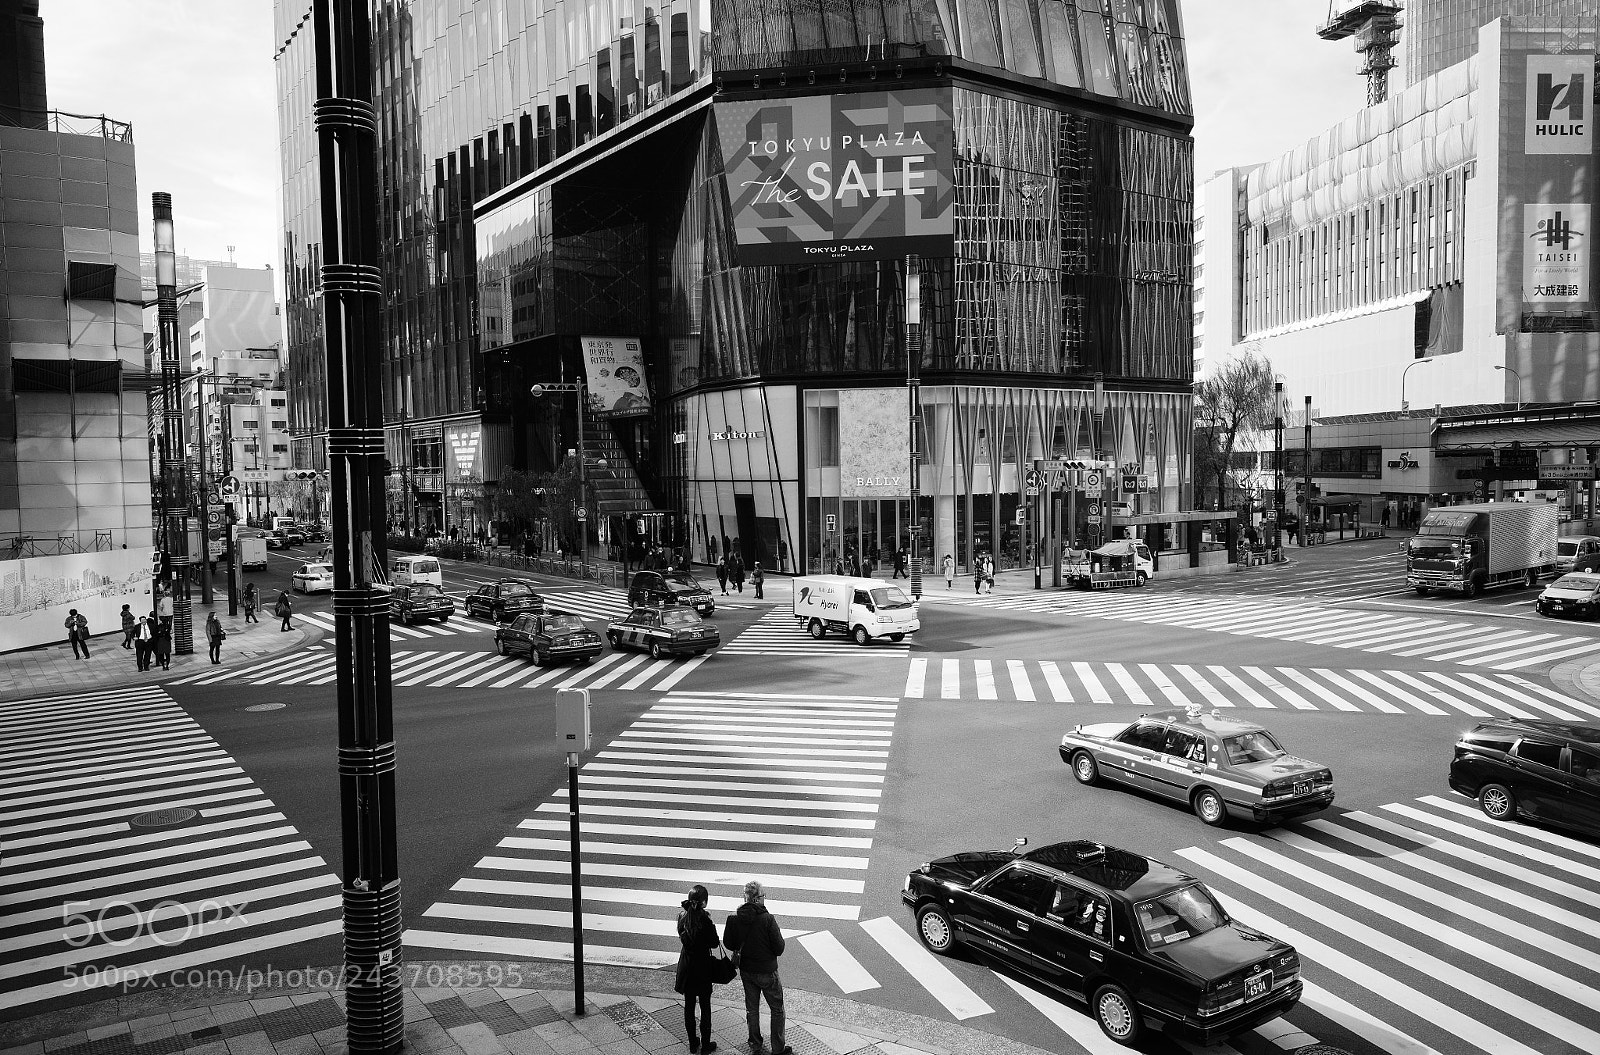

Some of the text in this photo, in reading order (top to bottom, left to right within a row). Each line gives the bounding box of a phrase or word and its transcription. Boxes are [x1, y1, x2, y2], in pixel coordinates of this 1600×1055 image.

[1535, 125, 1584, 136] HULIC
[748, 131, 924, 155] TOKYU PLAZA
[806, 155, 925, 201] SALE
[1538, 253, 1577, 262] TAISEI
[1533, 284, 1579, 297] 大成建設
[712, 430, 756, 441] Kiton
[856, 476, 900, 486] BALLY
